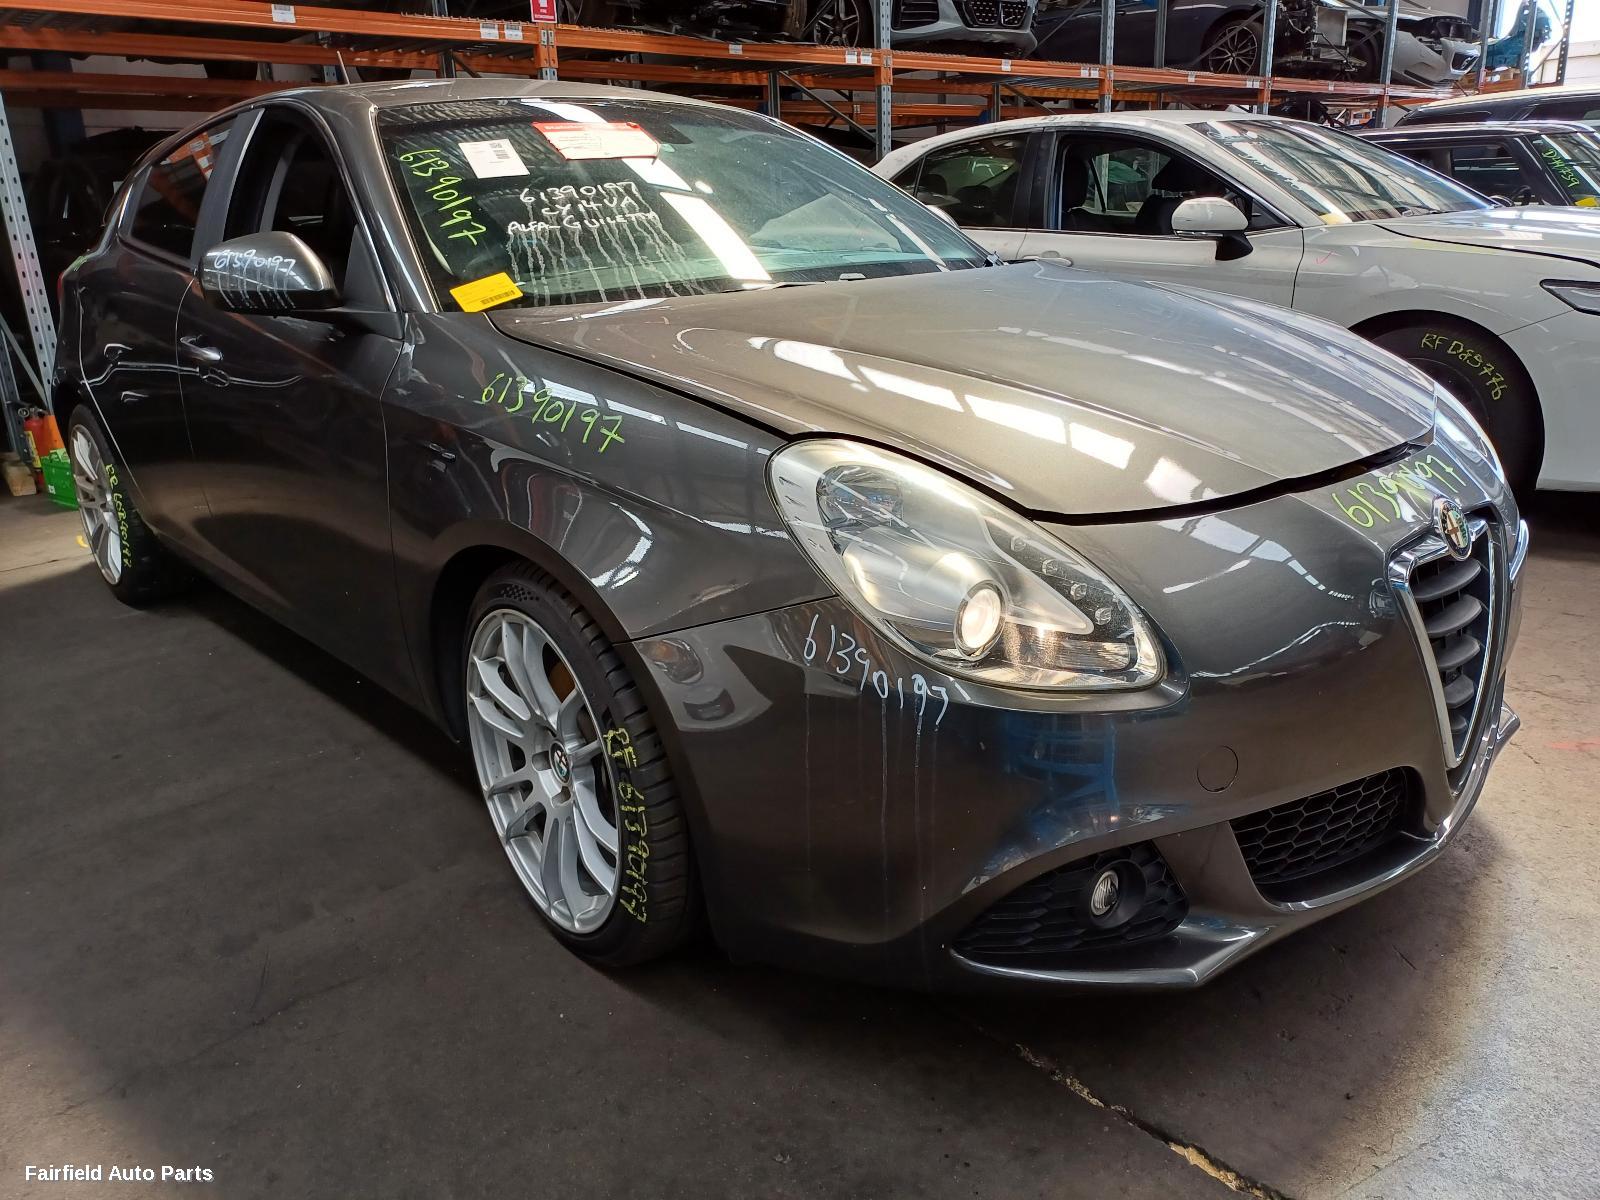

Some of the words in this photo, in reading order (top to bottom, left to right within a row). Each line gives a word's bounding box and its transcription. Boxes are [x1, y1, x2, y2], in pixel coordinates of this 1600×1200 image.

[400, 149, 487, 246] 61390197
[519, 181, 640, 204] 61390197
[1421, 333, 1448, 350] RF
[482, 373, 625, 453] 61390197
[803, 613, 949, 726] 61390197
[603, 728, 638, 769] RF
[618, 781, 650, 924] 61390197
